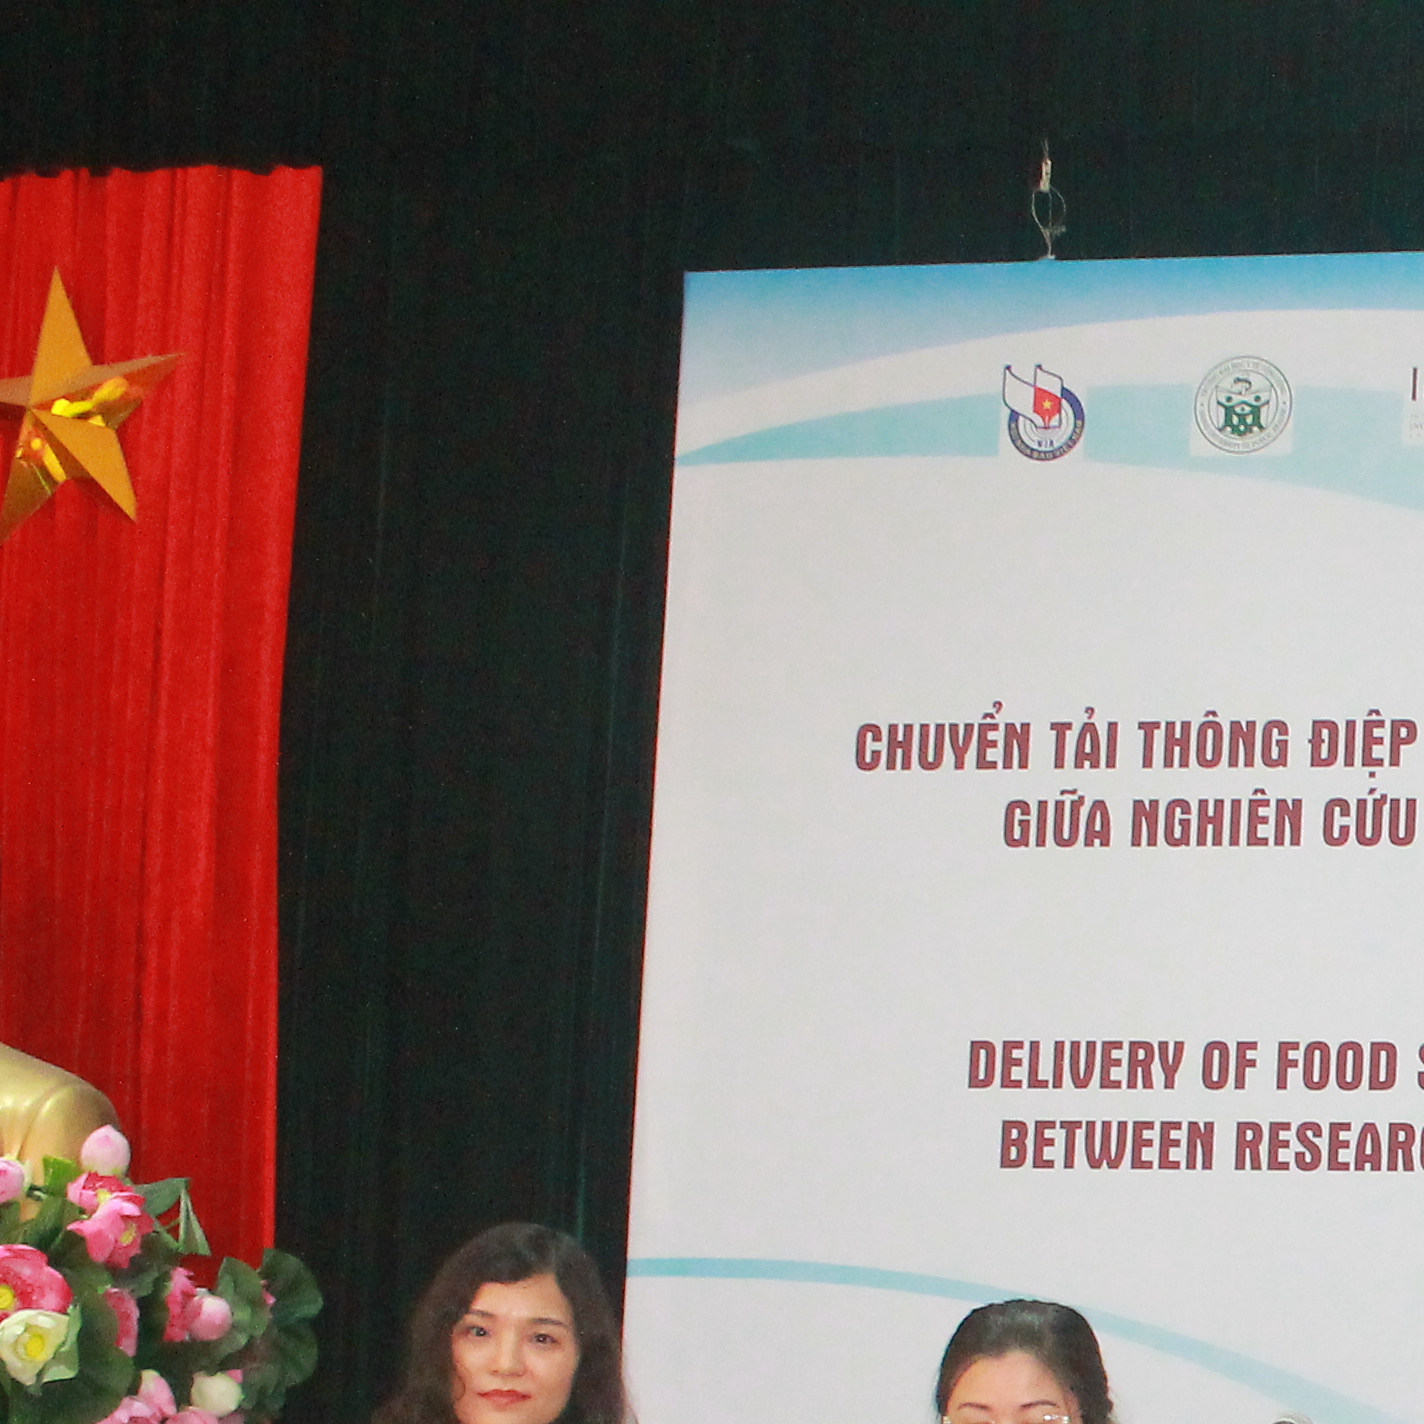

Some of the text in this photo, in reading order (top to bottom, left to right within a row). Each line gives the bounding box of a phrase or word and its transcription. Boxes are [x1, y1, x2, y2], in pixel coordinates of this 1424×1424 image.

[855, 701, 1031, 772] CHUYỂN
[1050, 706, 1120, 770] TẢI
[1138, 711, 1290, 770] THÔNG
[1308, 709, 1418, 779] ĐIỆP
[1004, 788, 1112, 849] GIỮA
[1131, 788, 1303, 848] NGHIÊN
[1323, 792, 1418, 848] CỨU
[968, 1040, 1187, 1090] DELIVERY
[1202, 1041, 1260, 1091] OF
[1276, 1041, 1399, 1092] FOOD
[1000, 1120, 1216, 1171] BETWEEN
